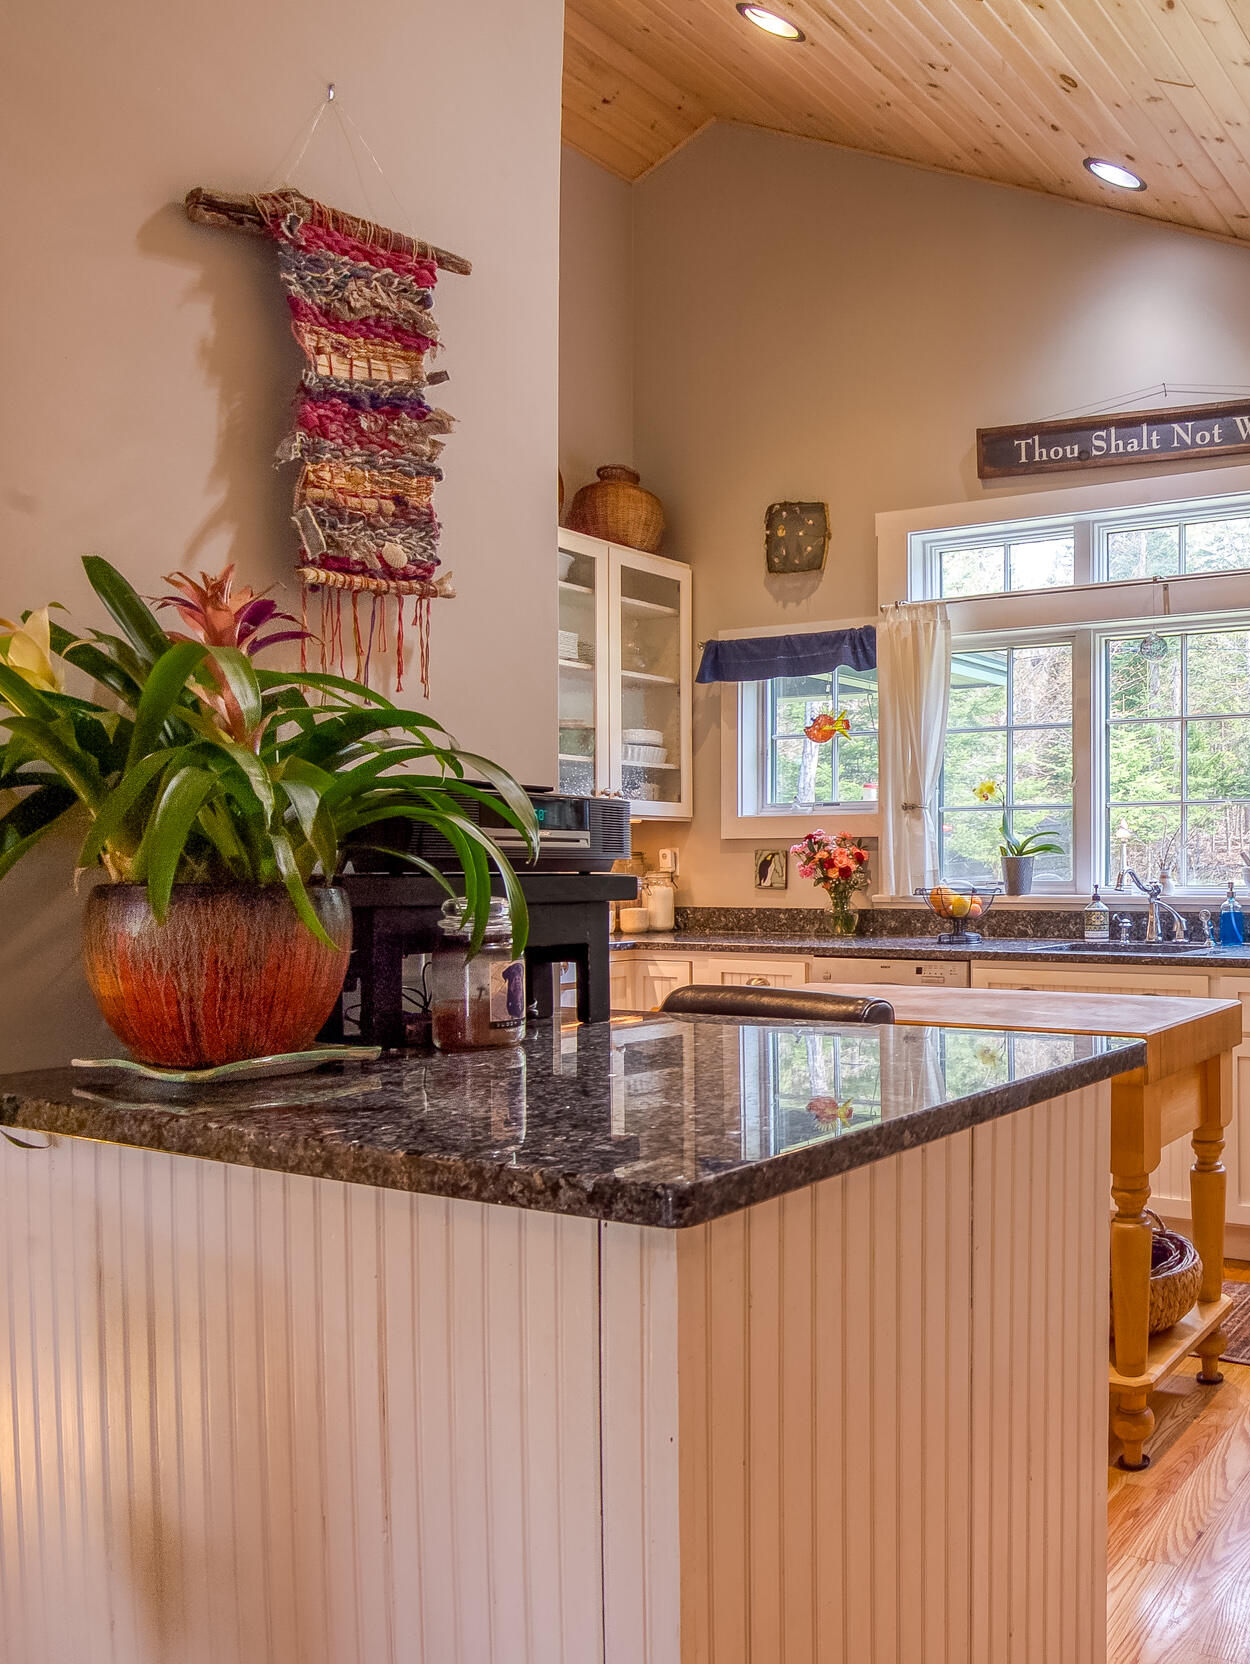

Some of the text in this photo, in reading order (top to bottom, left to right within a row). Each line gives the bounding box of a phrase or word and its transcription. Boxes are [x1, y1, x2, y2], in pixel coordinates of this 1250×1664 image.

[1014, 435, 1079, 463] Thou
[1091, 423, 1160, 457] Shalt
[1171, 422, 1223, 448] Not
